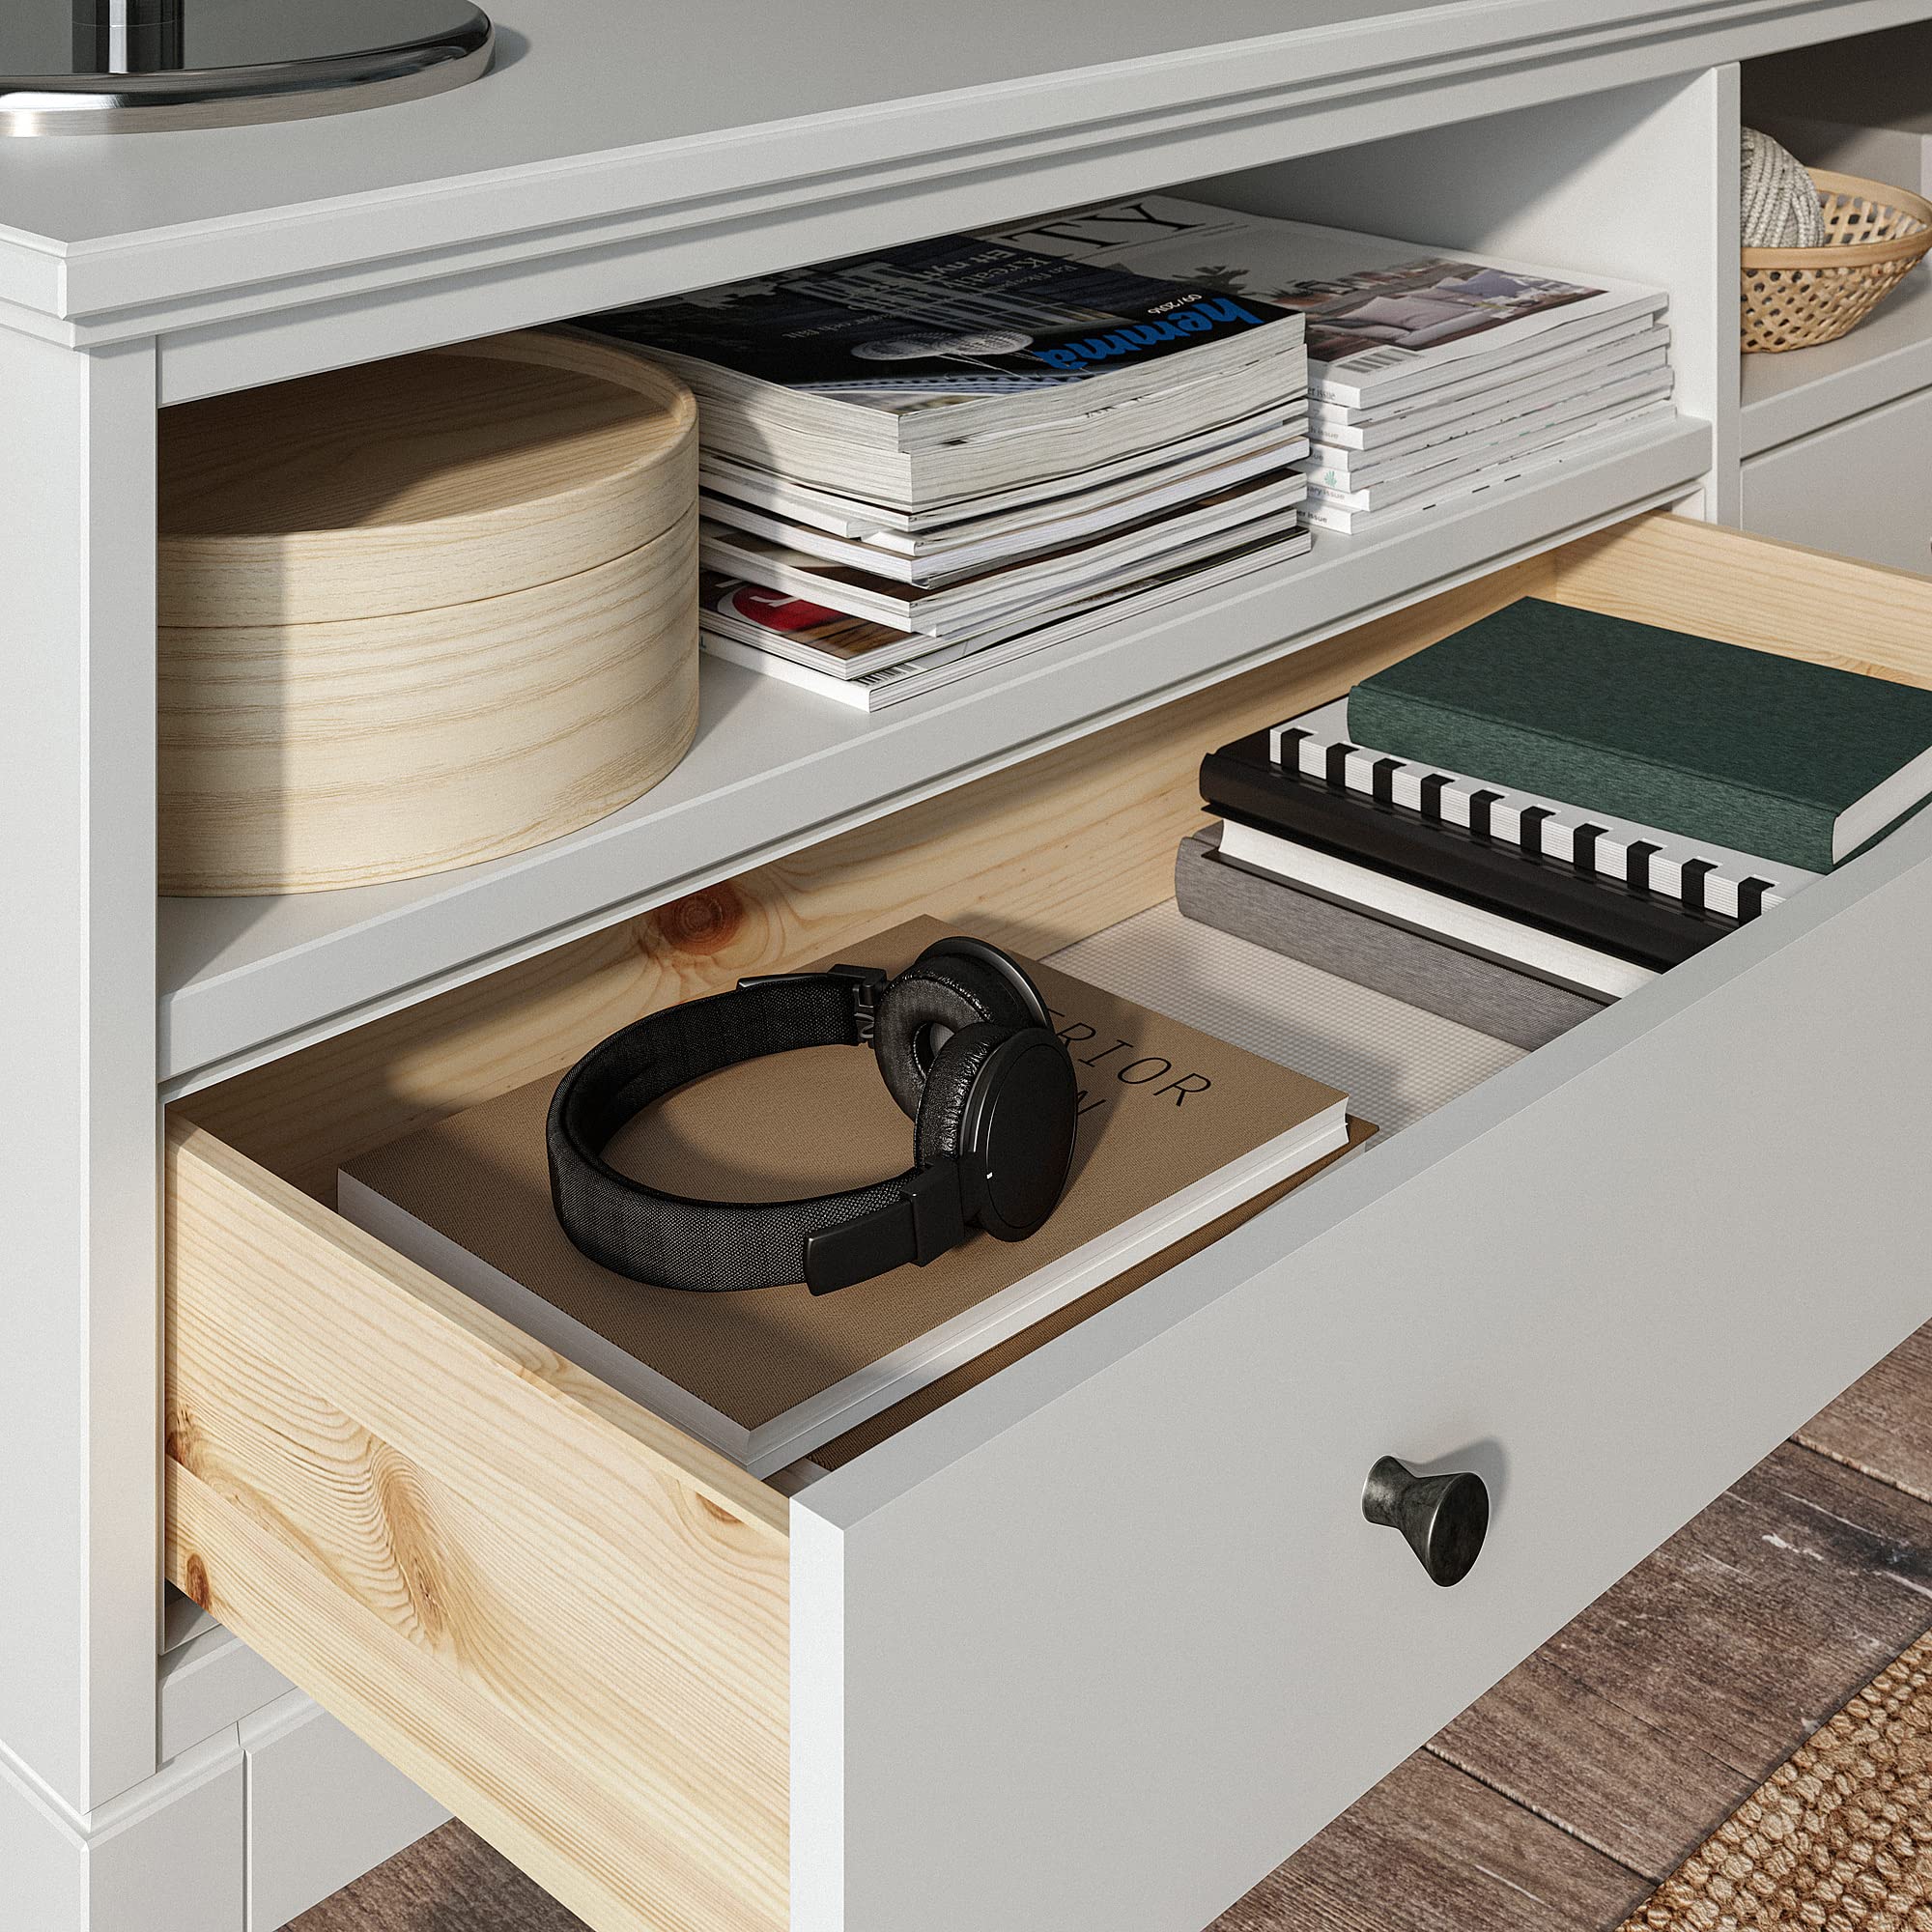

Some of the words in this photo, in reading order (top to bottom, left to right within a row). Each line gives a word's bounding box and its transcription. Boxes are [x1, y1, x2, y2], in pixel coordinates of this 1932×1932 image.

[999, 202, 1207, 257] TY
[1032, 298, 1264, 370] hemma
[1047, 1008, 1211, 1107] RIOR
